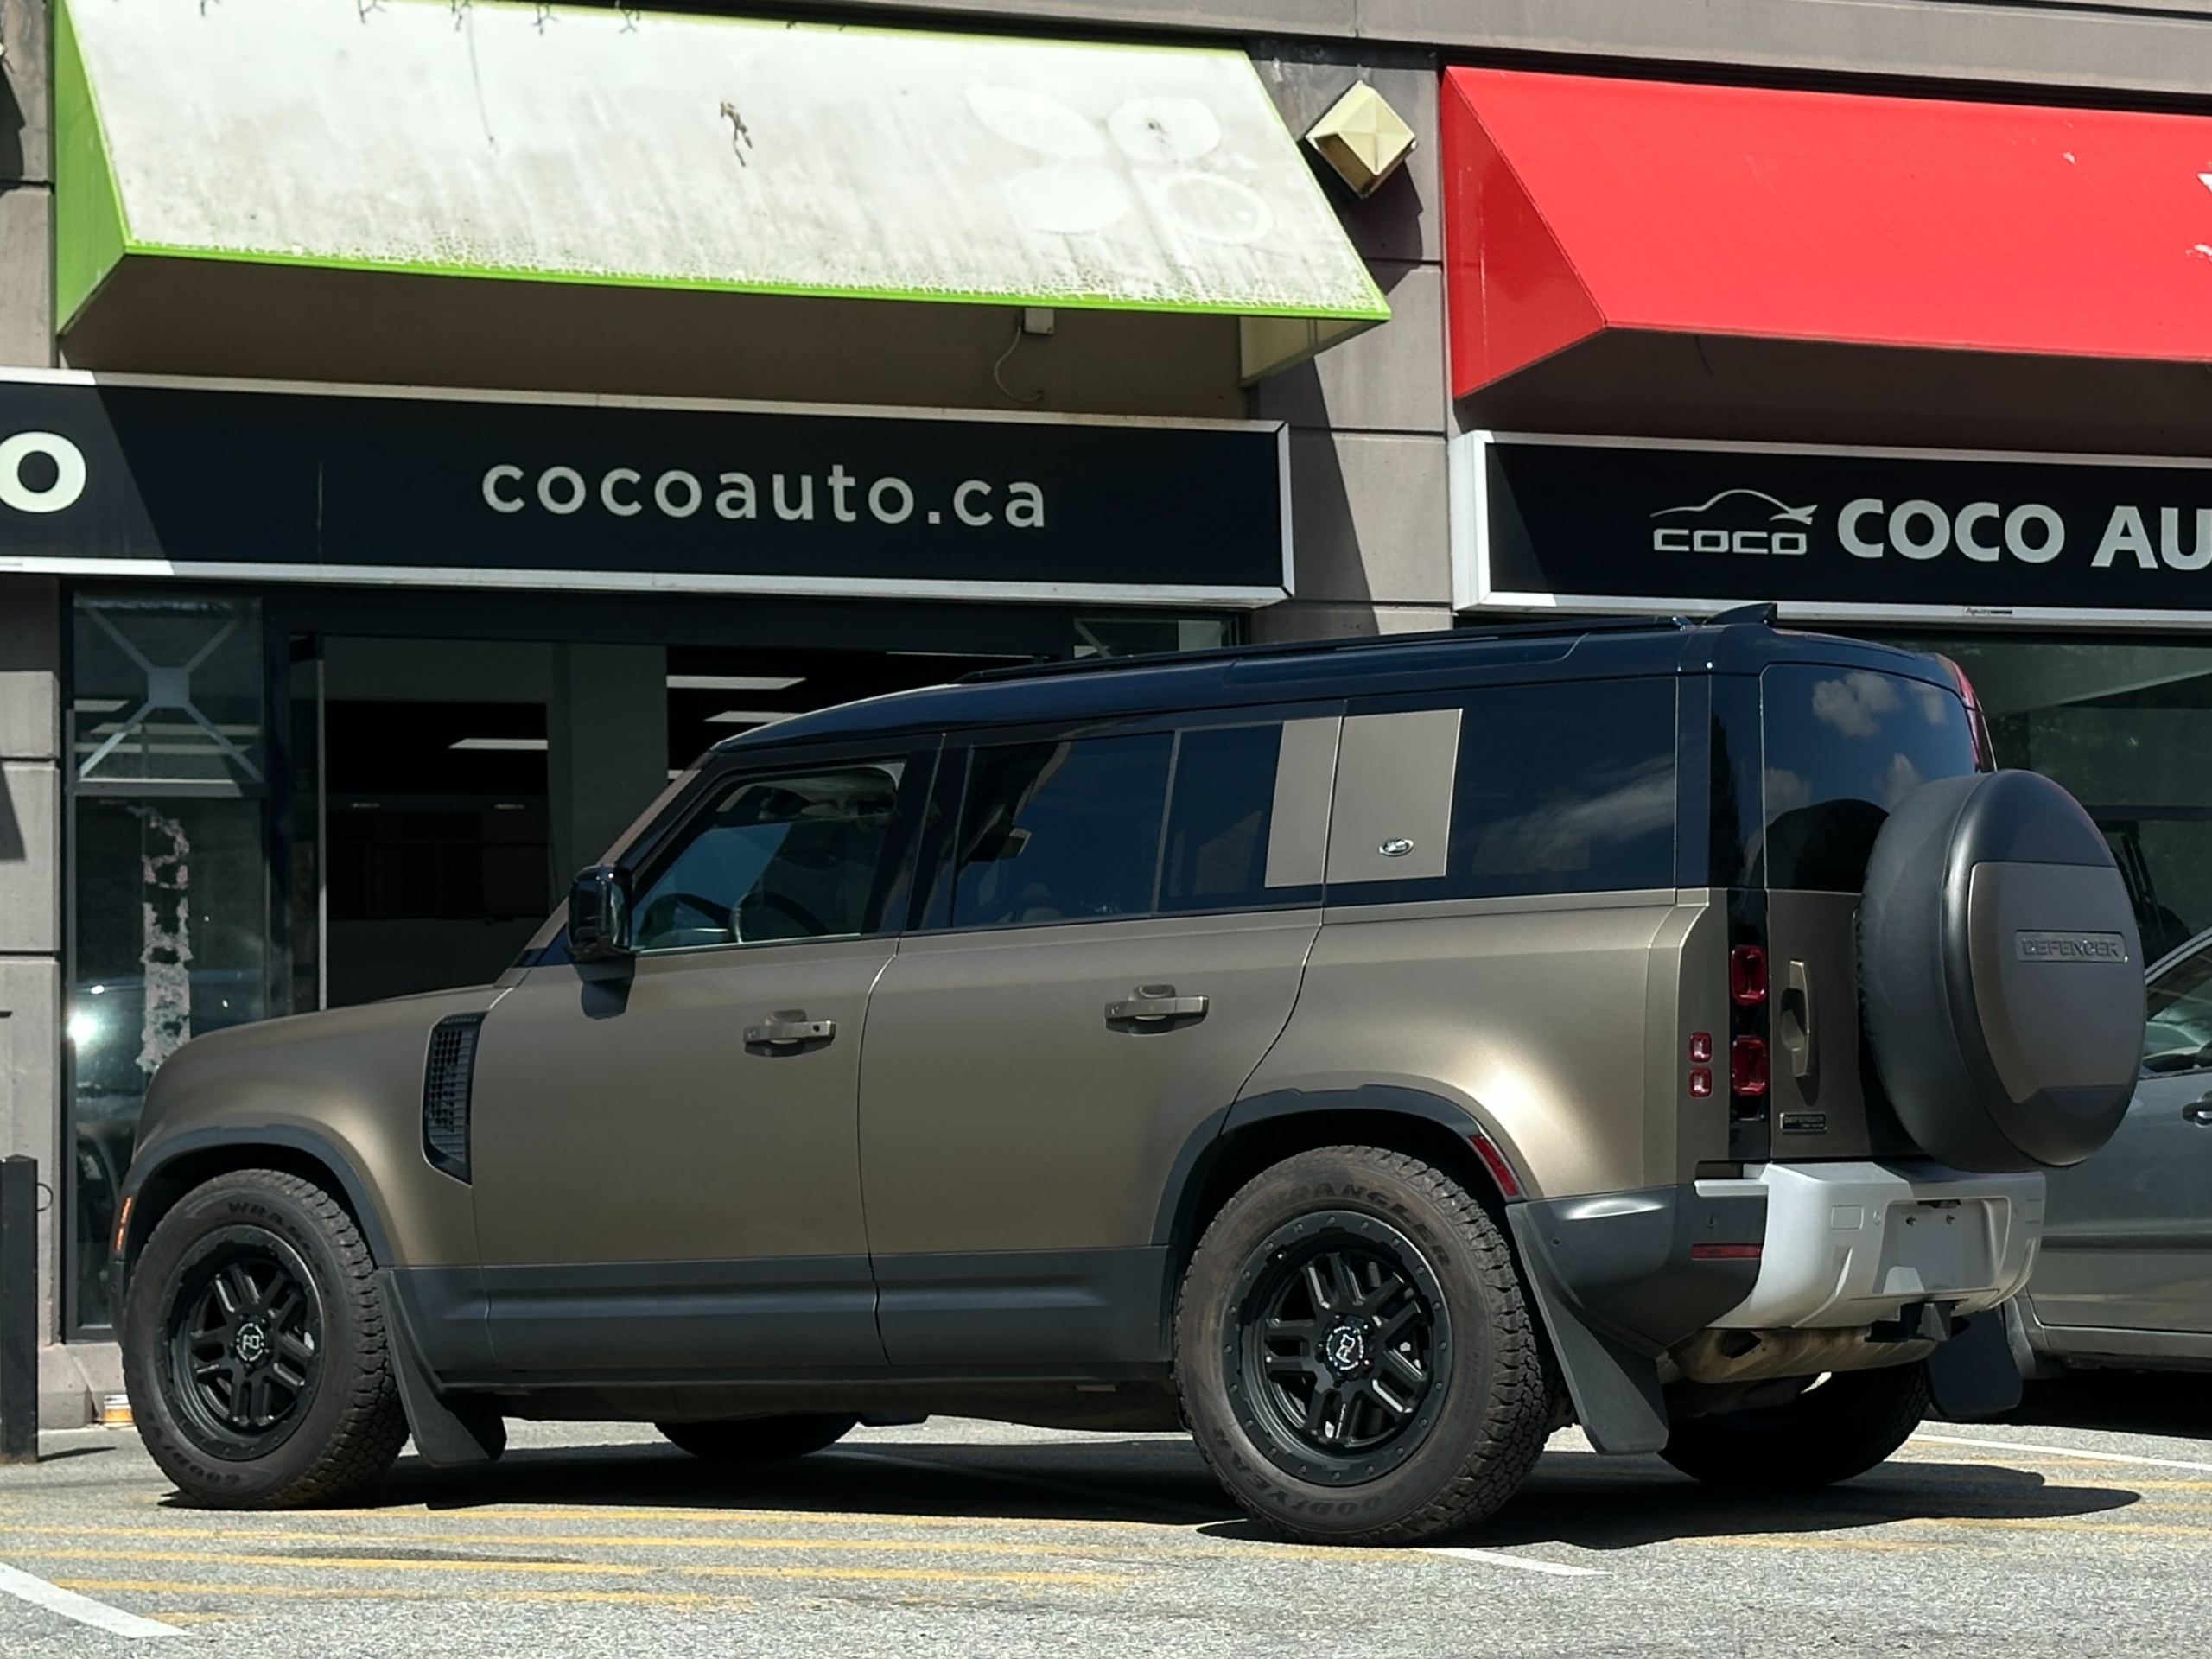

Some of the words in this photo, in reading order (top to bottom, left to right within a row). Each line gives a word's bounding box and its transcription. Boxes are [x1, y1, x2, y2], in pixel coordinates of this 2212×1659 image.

[481, 464, 1045, 528] cocoauto.ca
[1652, 527, 1808, 556] COCO
[1836, 497, 2066, 564] COCO
[2090, 505, 2212, 571] AU
[2021, 937, 2120, 957] DEFENDER
[1260, 1182, 1452, 1266] RANGLER
